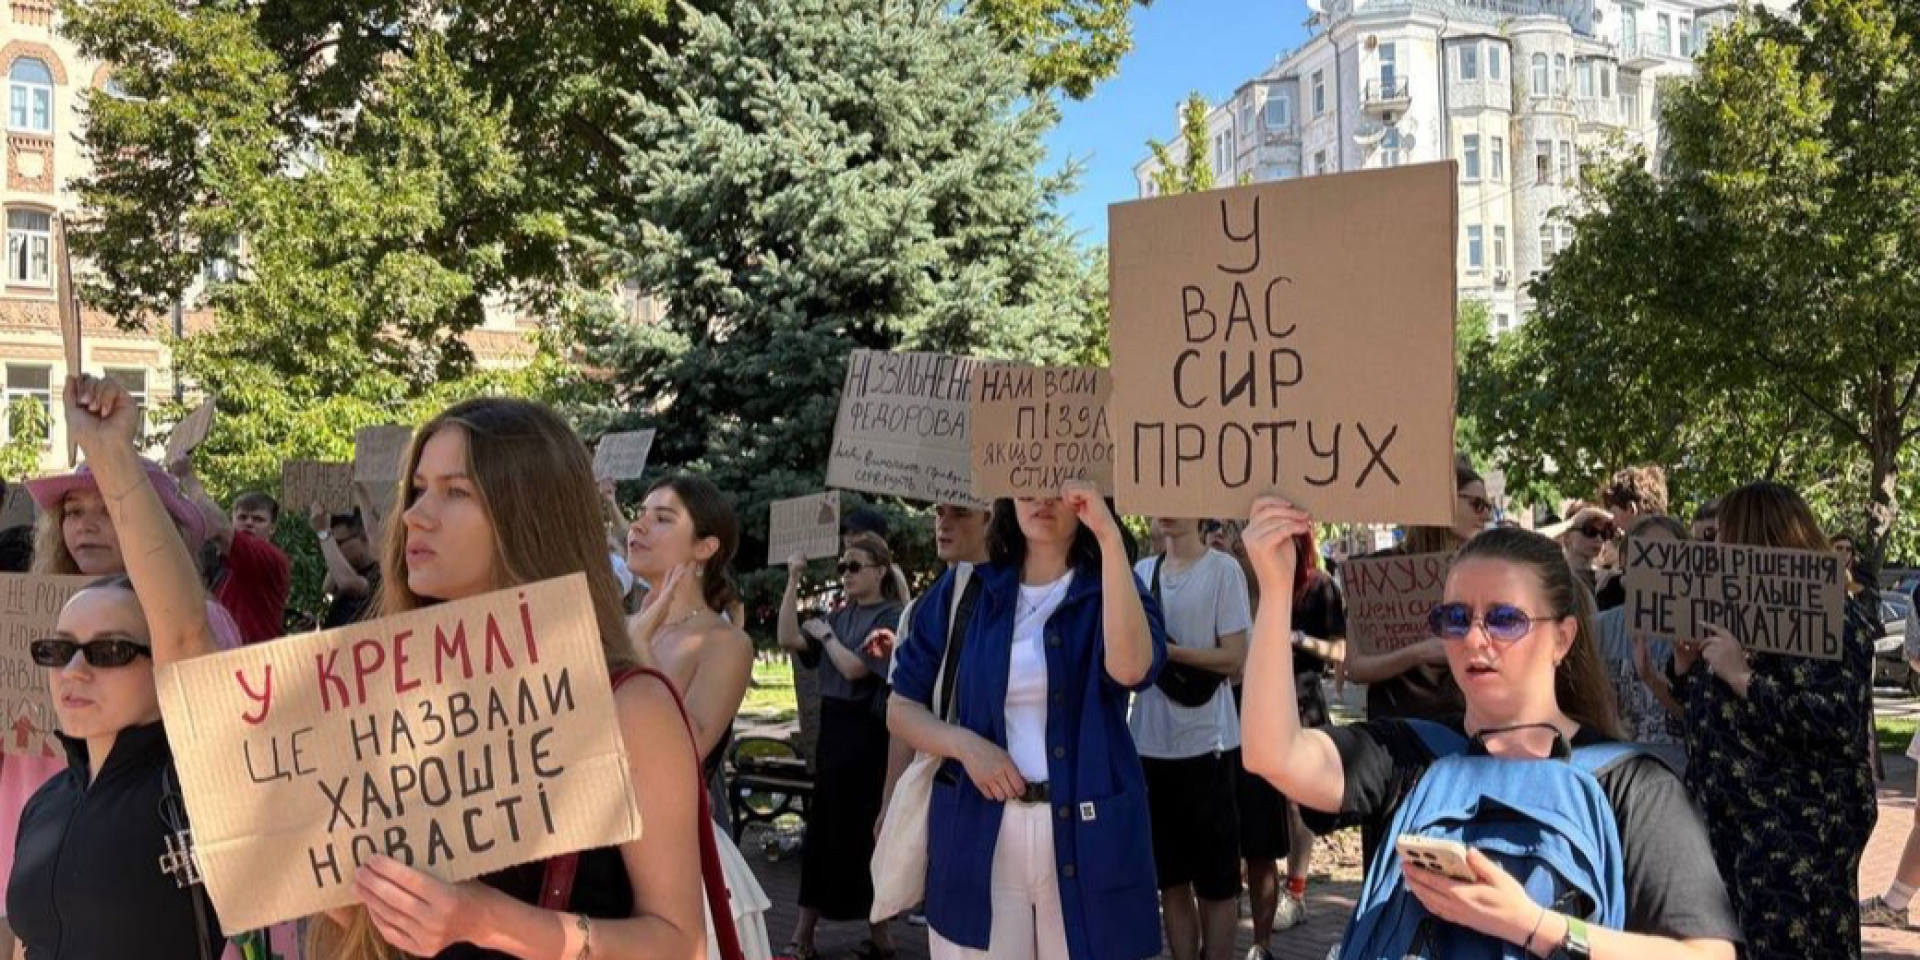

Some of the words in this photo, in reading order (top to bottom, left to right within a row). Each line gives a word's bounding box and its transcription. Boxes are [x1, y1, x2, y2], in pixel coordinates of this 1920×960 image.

[1217, 195, 1260, 274] У
[1181, 276, 1297, 343] ВАС
[981, 369, 1034, 403] НАМ
[1044, 367, 1098, 399] ВСІМ
[1173, 348, 1304, 408] СИР
[849, 401, 966, 440] ФЕДОРОВА
[983, 441, 1042, 466] ЯКЩО
[1133, 420, 1400, 489] ПРОТУХ
[1631, 540, 1725, 573] ХУЙОВІ
[1732, 548, 1838, 585] РІШЕННЯ
[1661, 571, 1714, 600] ТУТ
[1722, 576, 1824, 609] БІЛЬШЕ
[1634, 590, 1675, 634] НЕ
[1690, 597, 1838, 655] ПРОКАТЯТЬ
[235, 664, 273, 725] У
[315, 592, 540, 713] КРЕМЛІ
[243, 726, 318, 784] ЦЕ
[350, 667, 576, 762] НАЗВАЛИ
[318, 728, 564, 833] ХАРОШІЄ
[308, 782, 555, 888] НОВАСТІ
